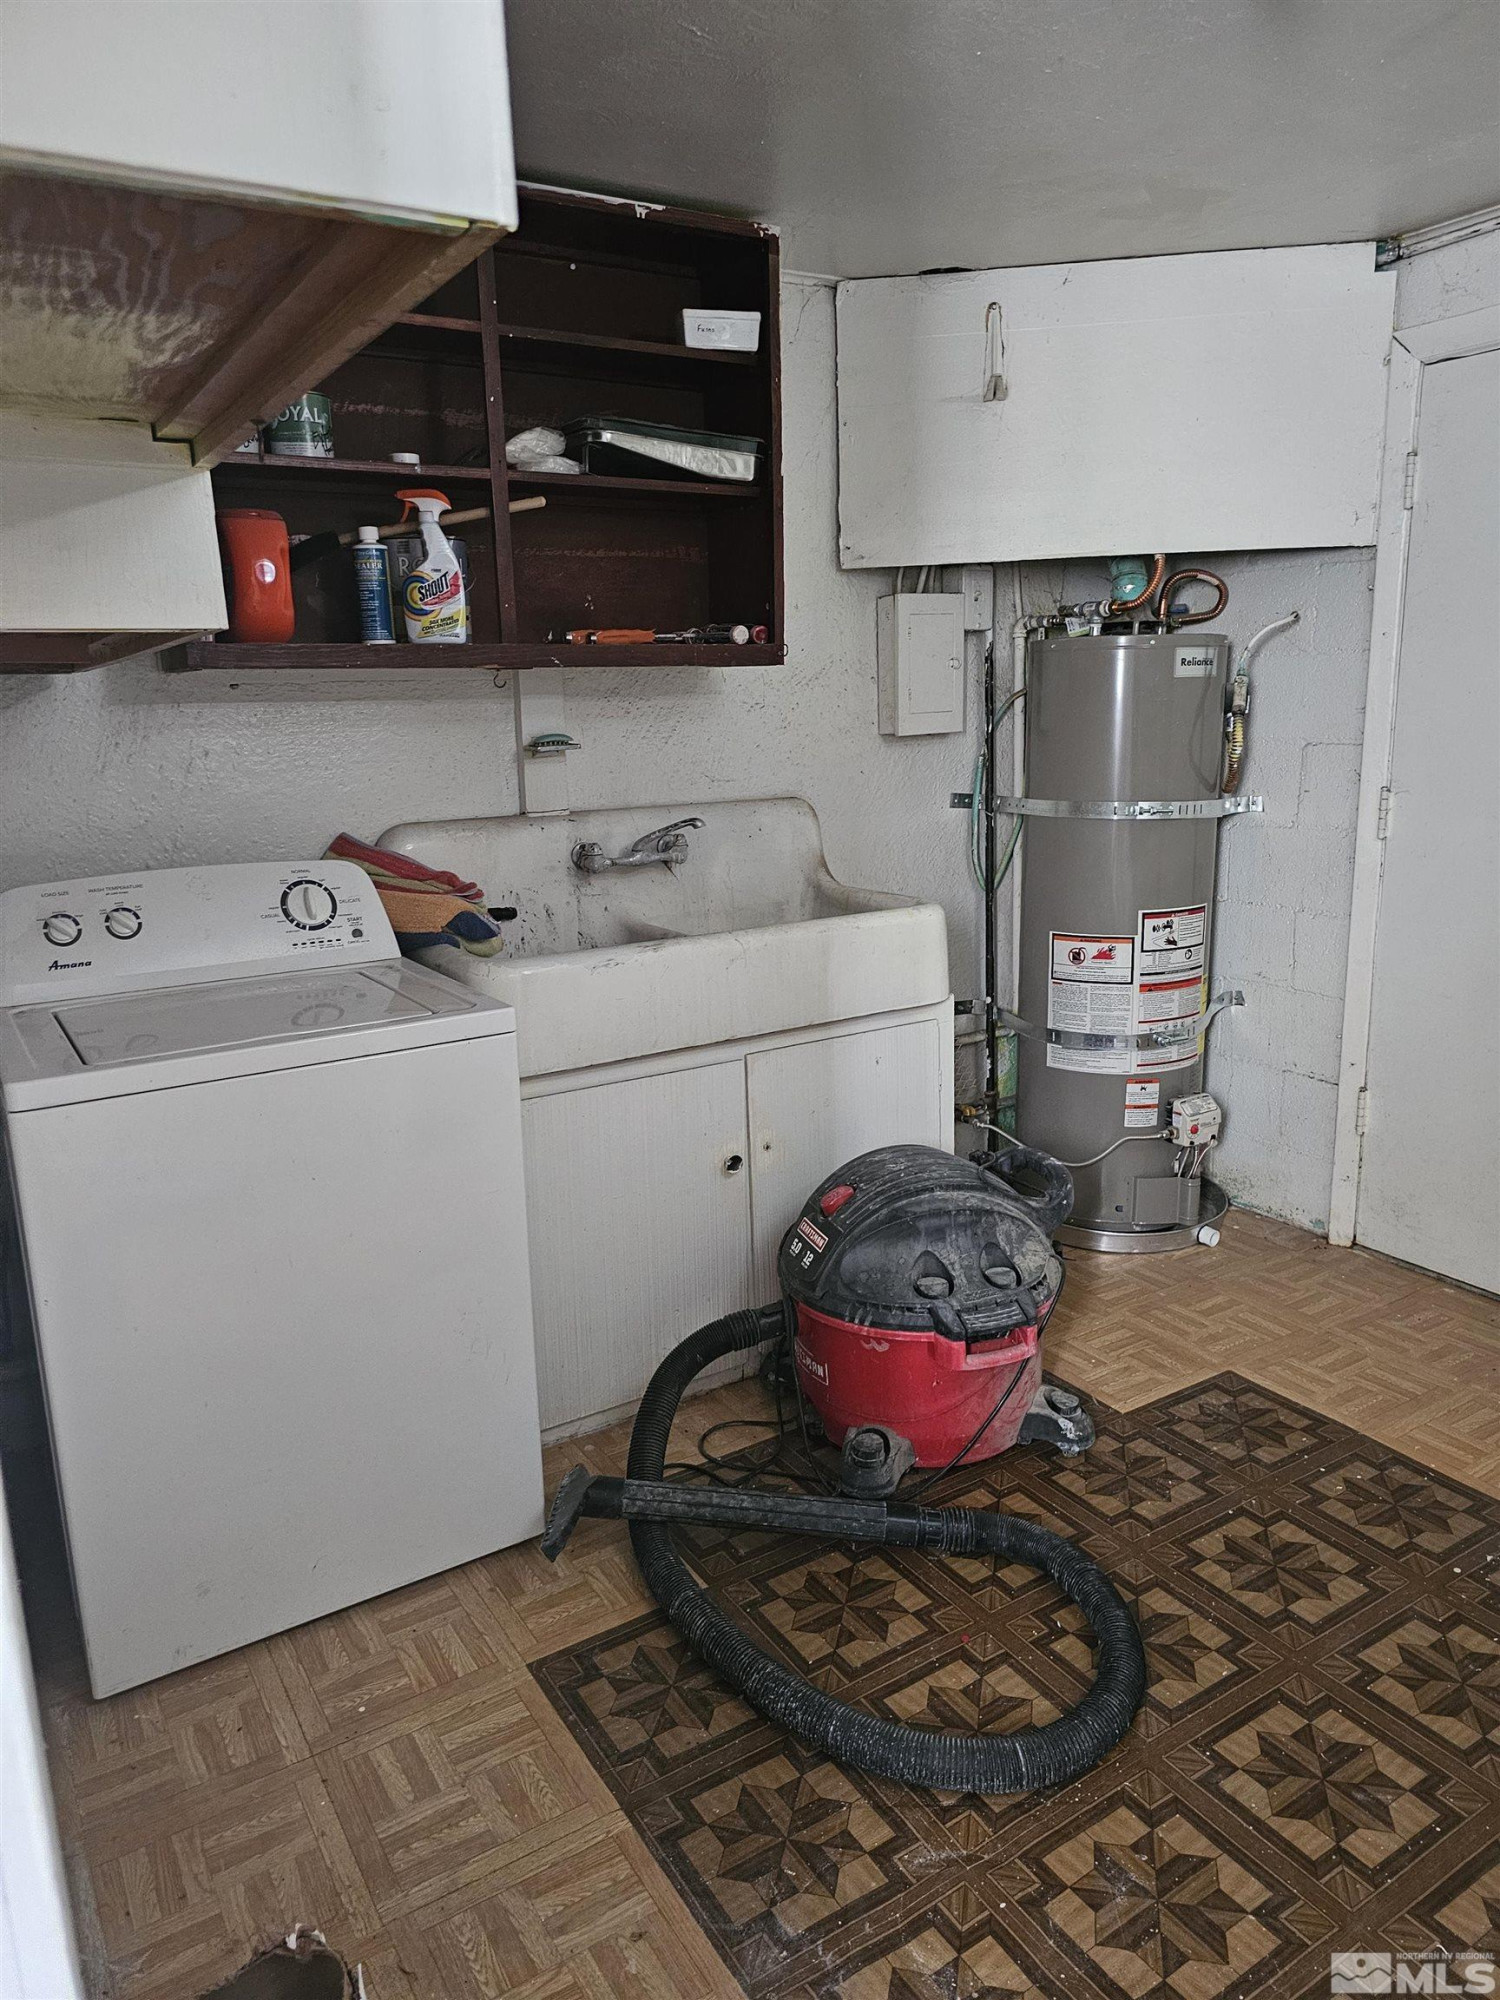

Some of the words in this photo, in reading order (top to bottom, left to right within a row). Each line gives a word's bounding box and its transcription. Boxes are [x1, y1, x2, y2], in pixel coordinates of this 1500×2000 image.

[273, 405, 323, 427] OYAL
[418, 571, 450, 602] SHOUT
[1180, 656, 1214, 667] Reliance
[48, 960, 93, 972] Amana
[800, 1221, 826, 1248] CRAFTSMAN
[790, 1238, 802, 1254] 5.0
[803, 1250, 814, 1266] 12
